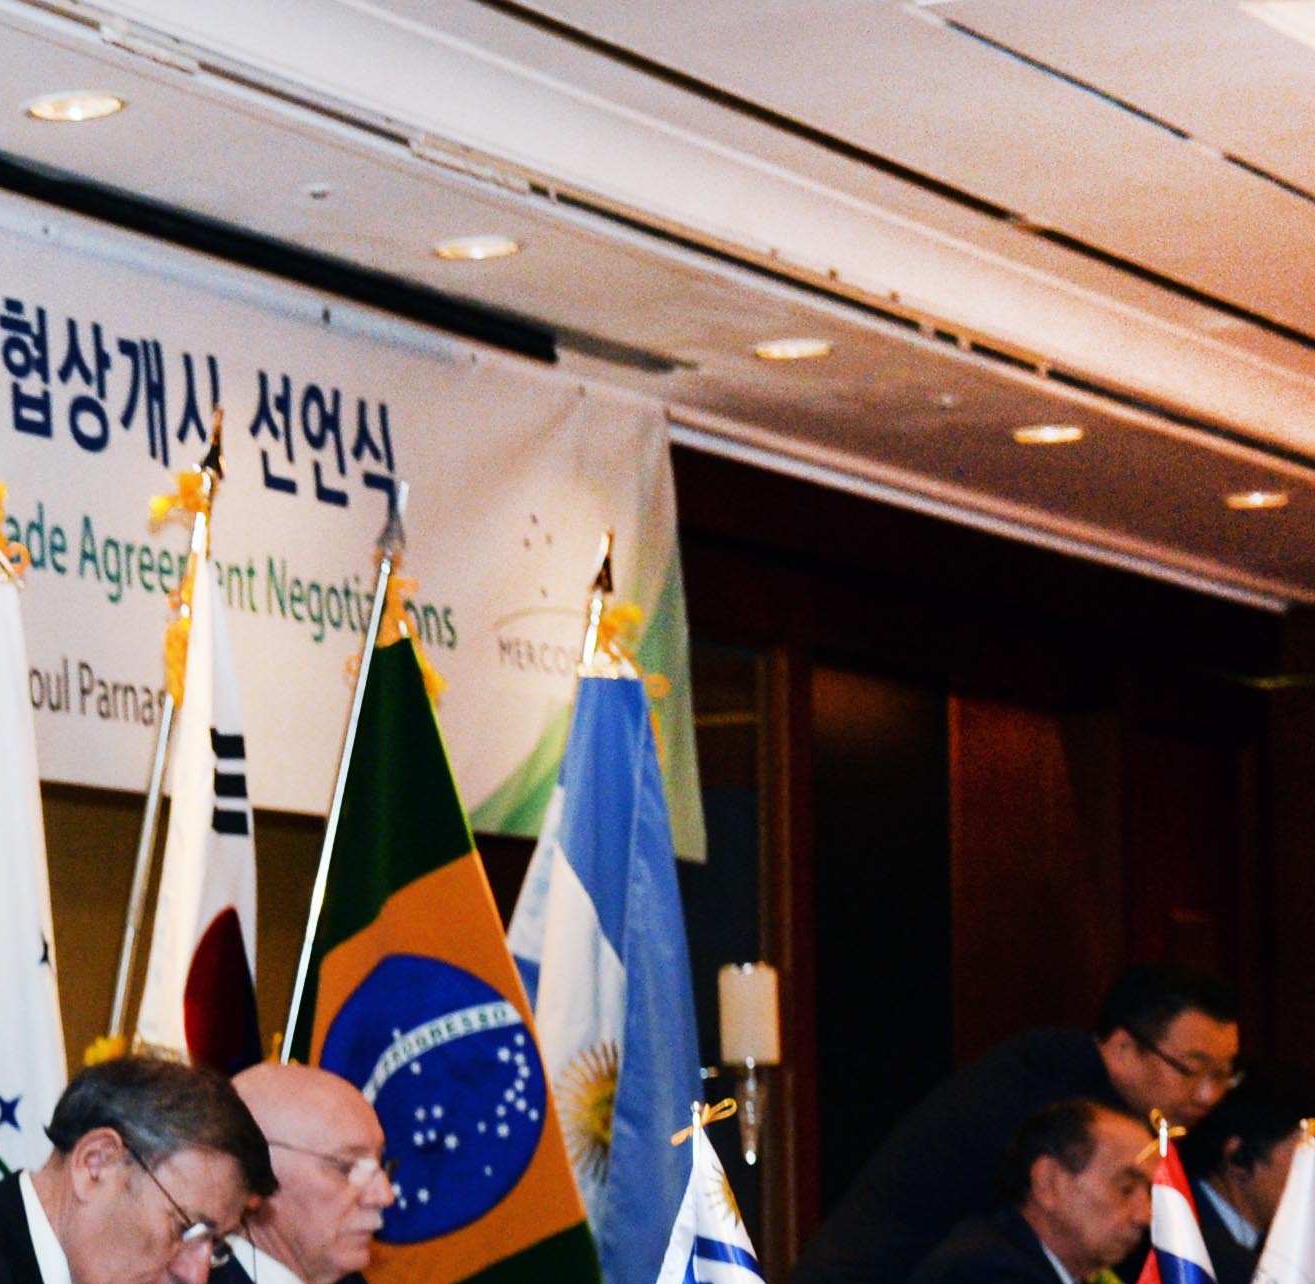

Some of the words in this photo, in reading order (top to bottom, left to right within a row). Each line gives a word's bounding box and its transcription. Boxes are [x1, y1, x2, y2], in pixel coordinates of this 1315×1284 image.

[249, 370, 397, 512] 선언식
[78, 515, 258, 613] Agreent
[29, 656, 70, 713] oul
